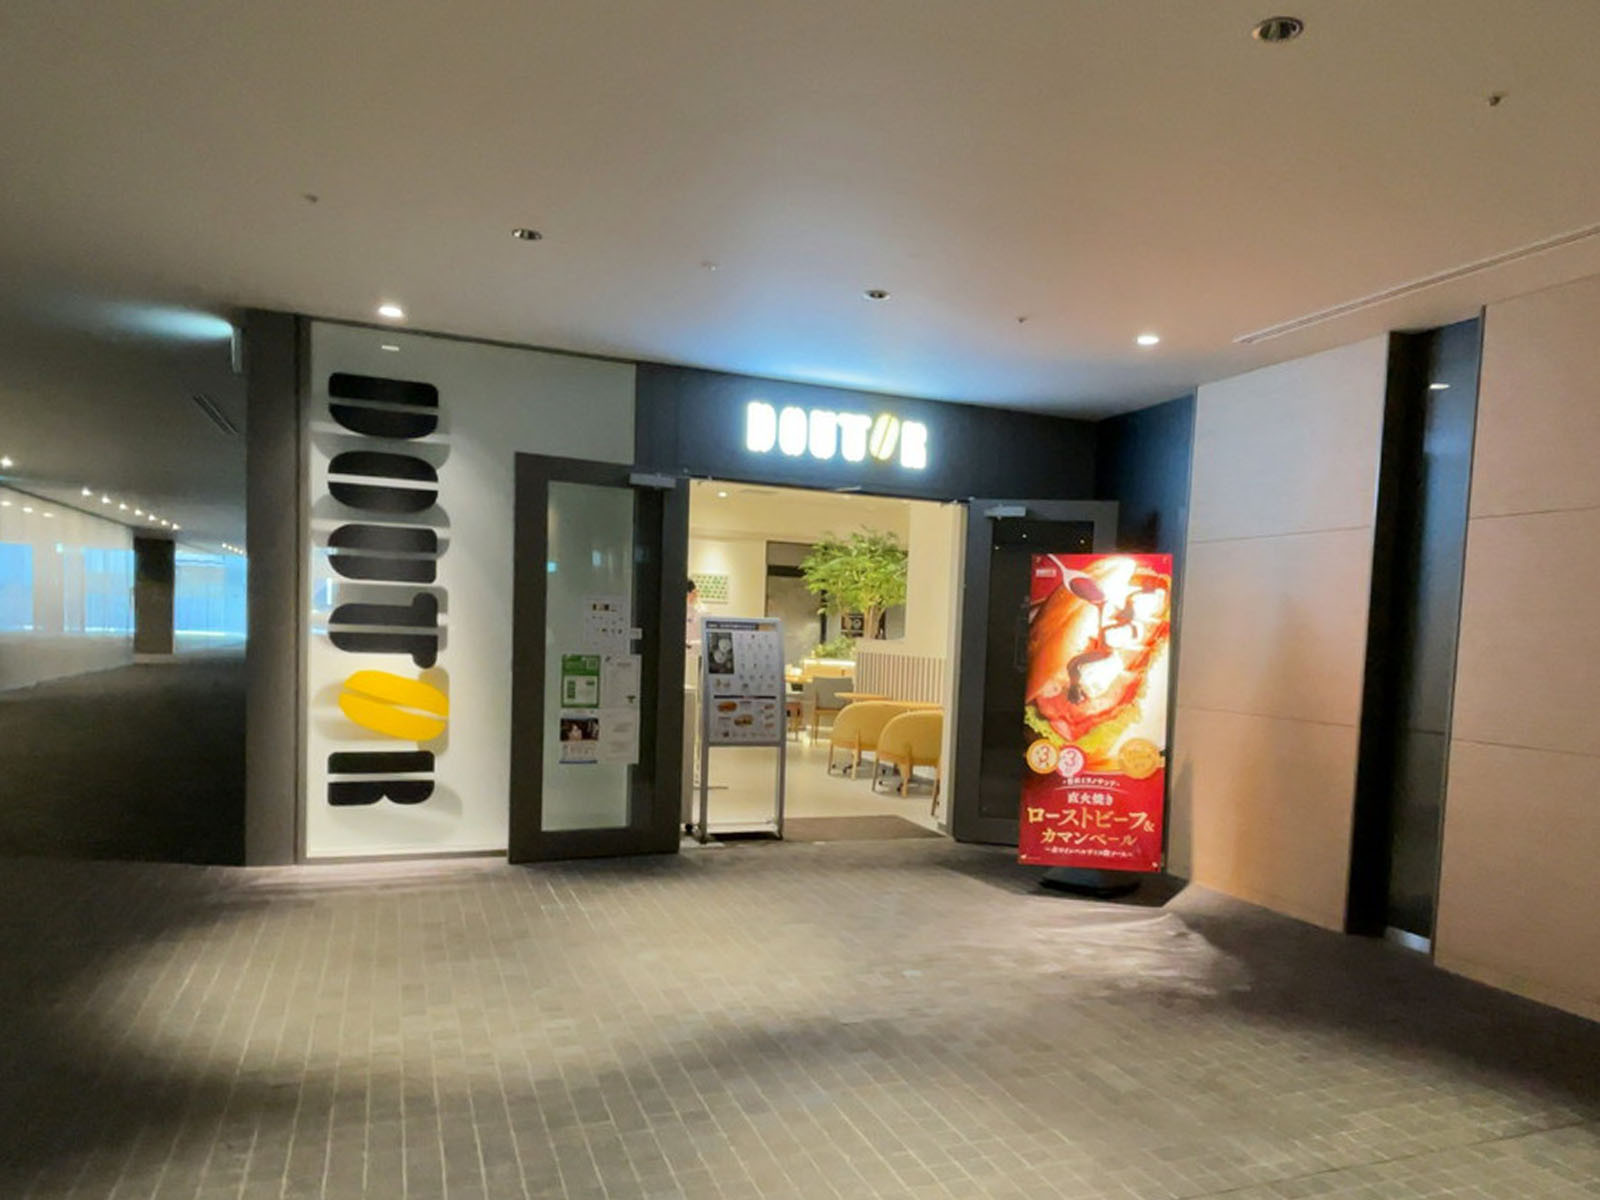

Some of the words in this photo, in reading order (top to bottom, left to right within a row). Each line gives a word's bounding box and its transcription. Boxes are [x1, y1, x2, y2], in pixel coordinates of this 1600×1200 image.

[746, 402, 927, 470] DOUTOR
[327, 372, 449, 807] DOUTOR
[1040, 828, 1137, 846] カマンベール
